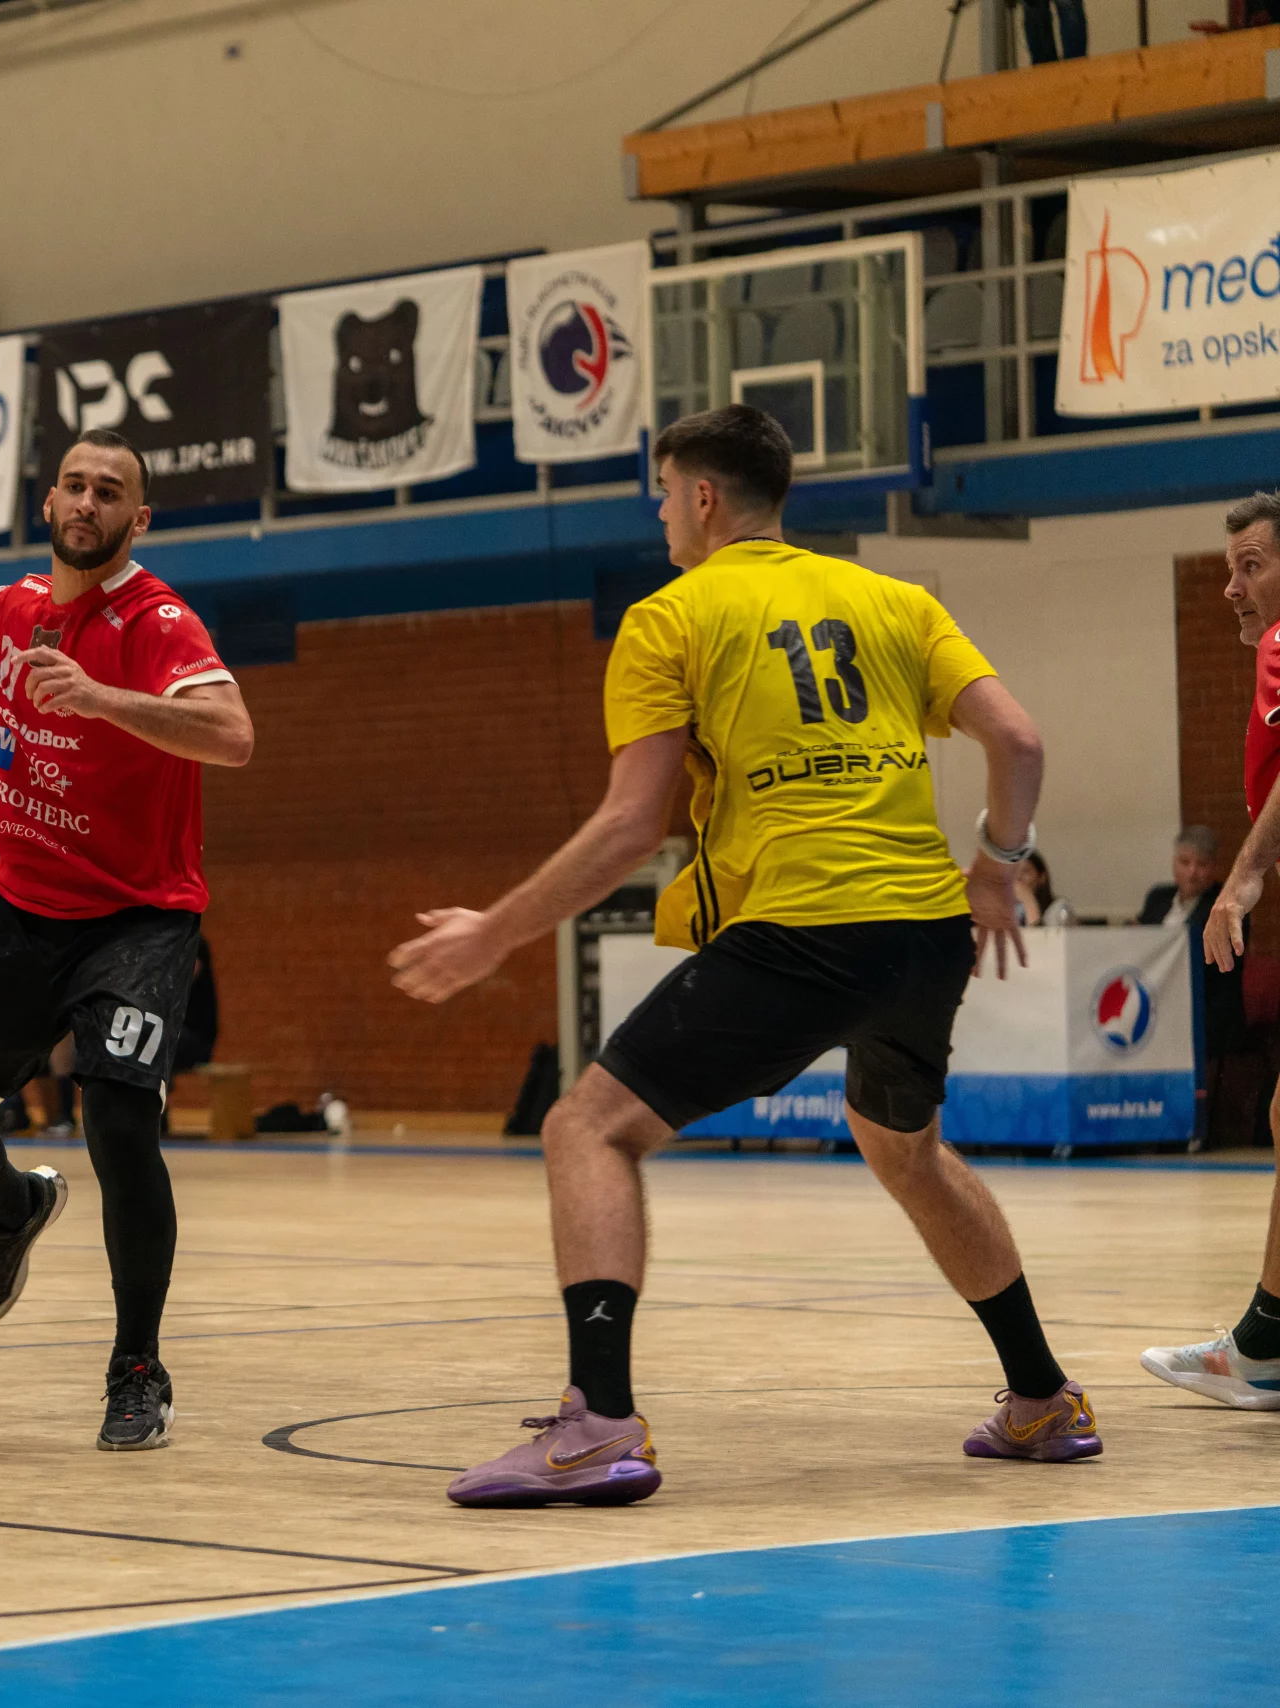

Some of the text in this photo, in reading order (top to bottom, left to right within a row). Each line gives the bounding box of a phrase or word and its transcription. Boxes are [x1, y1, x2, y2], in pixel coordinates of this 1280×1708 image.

[1162, 322, 1280, 367] za opsk
[767, 617, 869, 725] 13
[746, 751, 931, 792] DUBRAVA
[105, 1006, 163, 1065] 97
